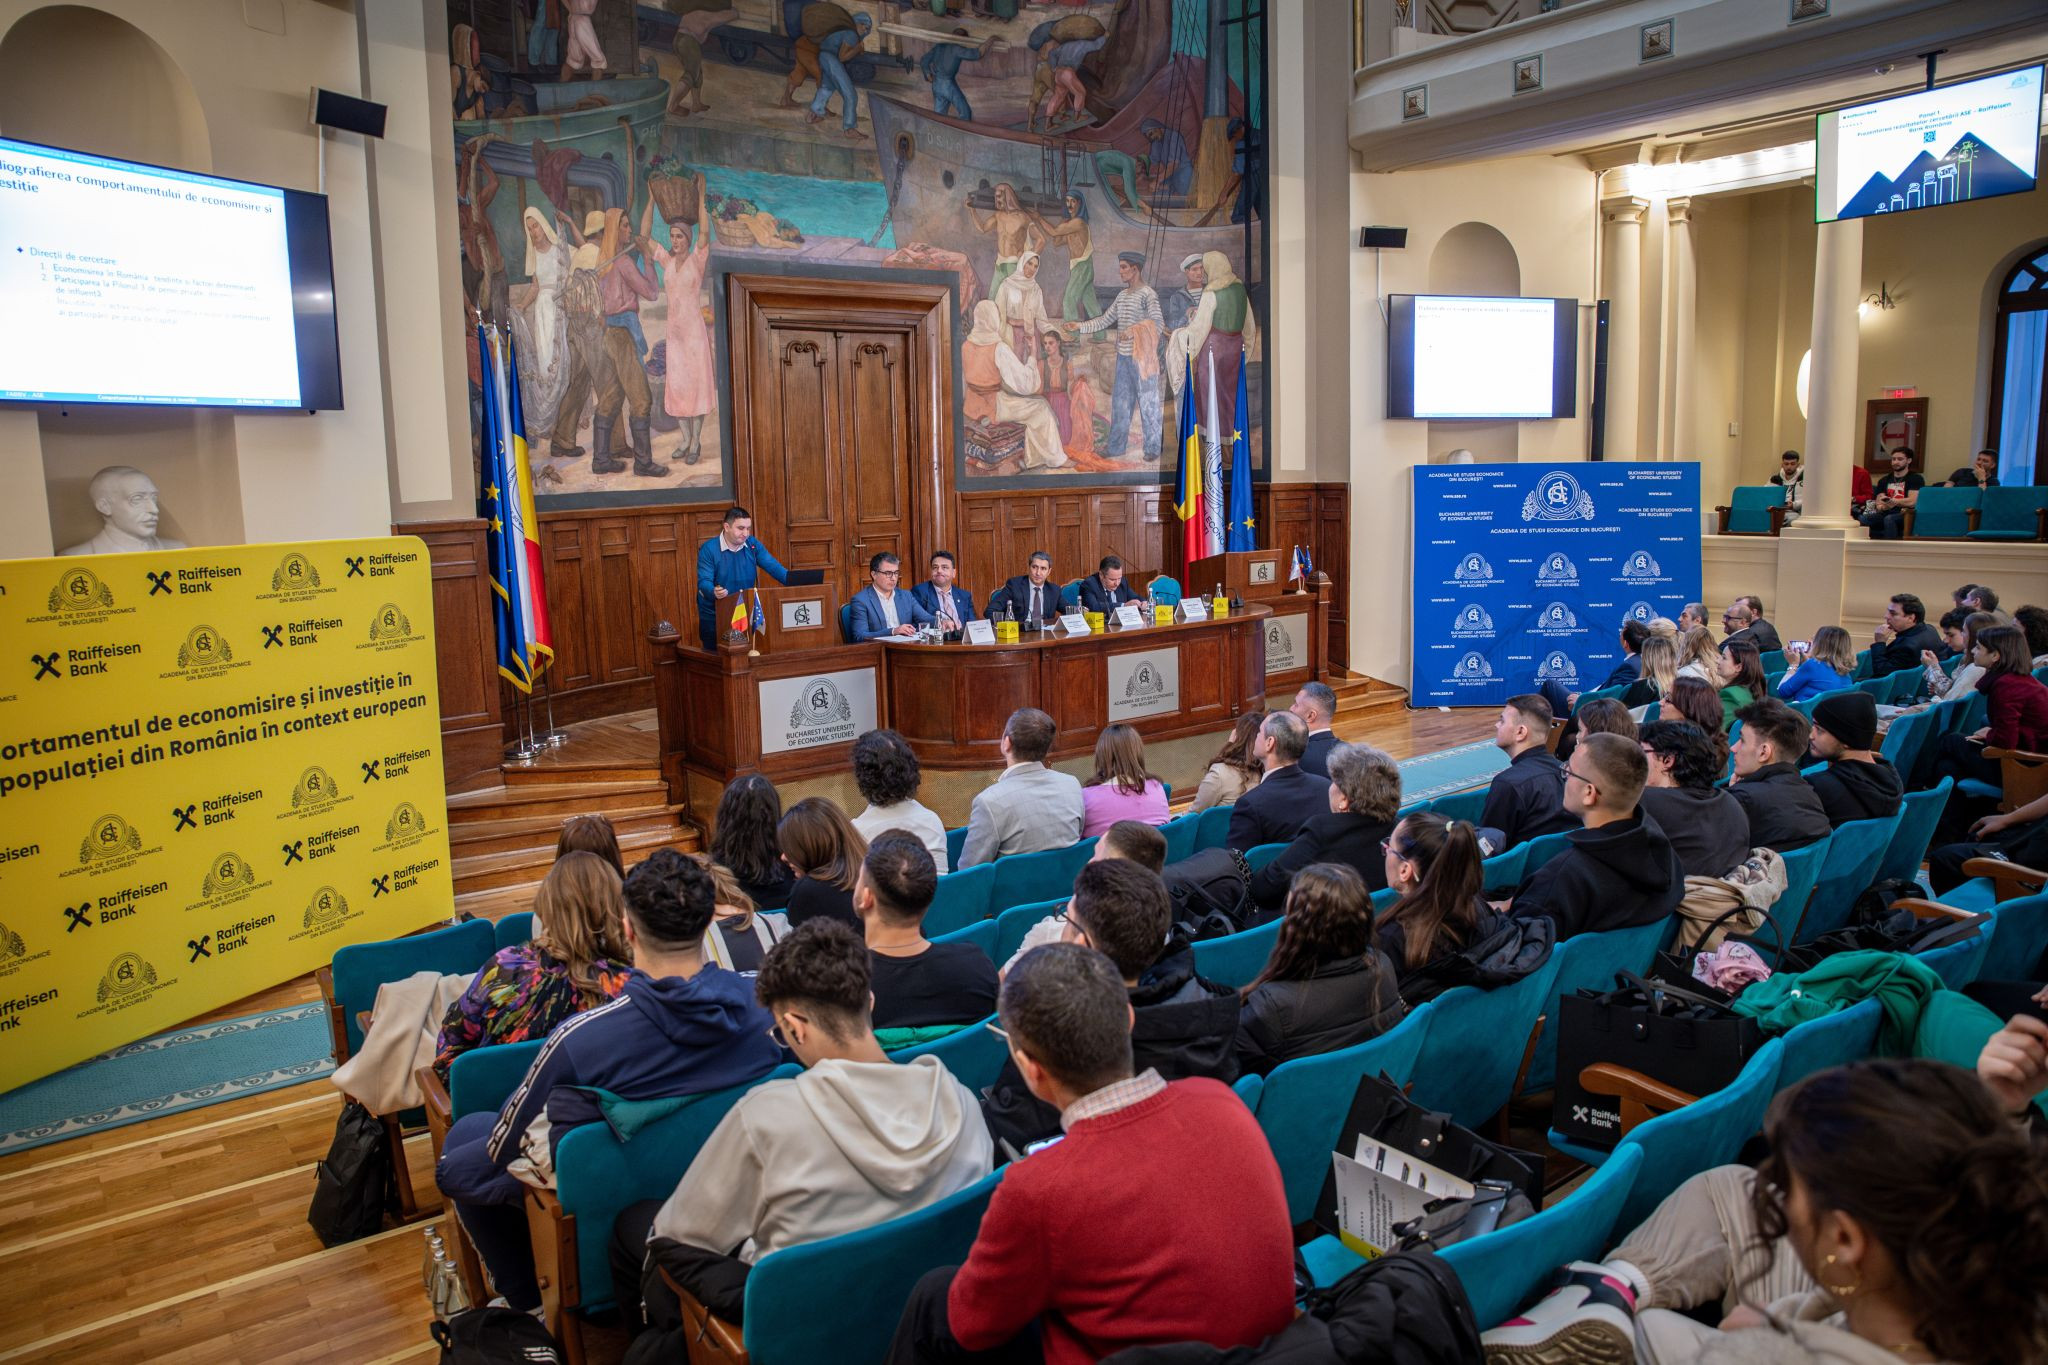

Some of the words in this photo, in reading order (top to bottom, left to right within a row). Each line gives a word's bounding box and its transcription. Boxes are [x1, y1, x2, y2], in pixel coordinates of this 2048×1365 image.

[1978, 102, 2011, 113] Raiffeisen
[76, 175, 180, 199] comportamentului
[185, 192, 198, 201] de
[201, 197, 260, 212] economisire
[1205, 515, 1225, 546] ECONO
[369, 553, 417, 565] Raiffeisen
[178, 566, 241, 580] Raiffeisen
[370, 565, 394, 577] Bank
[180, 581, 212, 594] Bank
[26, 614, 62, 623] ACADEMIA
[98, 607, 136, 616] ECONOMICE
[288, 618, 343, 634] Raiffeisen
[290, 633, 318, 647] Bank
[68, 643, 141, 662] Raiffeisen
[70, 662, 108, 677] Bank
[160, 669, 190, 678] ACADEMIA
[219, 661, 251, 670] ECONOMICE
[146, 716, 172, 734] de
[178, 694, 295, 728] economisire
[301, 687, 314, 709] și
[319, 674, 394, 702] investiție
[398, 672, 412, 688] în
[786, 728, 821, 739] BUCHAREST
[822, 723, 855, 734] UNIVERSITY
[798, 734, 829, 745] ECONOMIC
[830, 731, 854, 740] STUDIES
[0, 749, 124, 797] populației
[131, 744, 164, 765] din
[170, 726, 257, 757] România
[261, 722, 279, 738] în
[284, 707, 349, 734] context
[353, 695, 426, 720] european
[384, 748, 430, 768] Raiffeisen
[385, 765, 409, 779] Bank
[202, 789, 262, 812] Raiffeisen
[204, 809, 235, 826] Bank
[307, 824, 360, 847] Raiffeisen
[309, 844, 336, 860] Bank
[58, 864, 94, 878] ACADEMIA
[127, 846, 163, 861] ECONOMICE
[393, 859, 439, 881] Raiffeisen
[89, 868, 101, 877] DIN
[394, 876, 418, 892] Bank
[99, 881, 168, 910] Raiffeisen
[100, 905, 136, 924] Bank
[216, 913, 275, 941] Raiffeisen
[218, 936, 248, 954] Bank
[9, 950, 51, 968] ECONOMICE
[76, 1001, 110, 1019] ACADEMIA
[112, 998, 120, 1006] DE
[143, 978, 178, 995] ECONOMICE
[106, 1005, 117, 1015] DIN
[1592, 1109, 1621, 1123] Raiffeis
[1592, 1117, 1612, 1128] Bank
